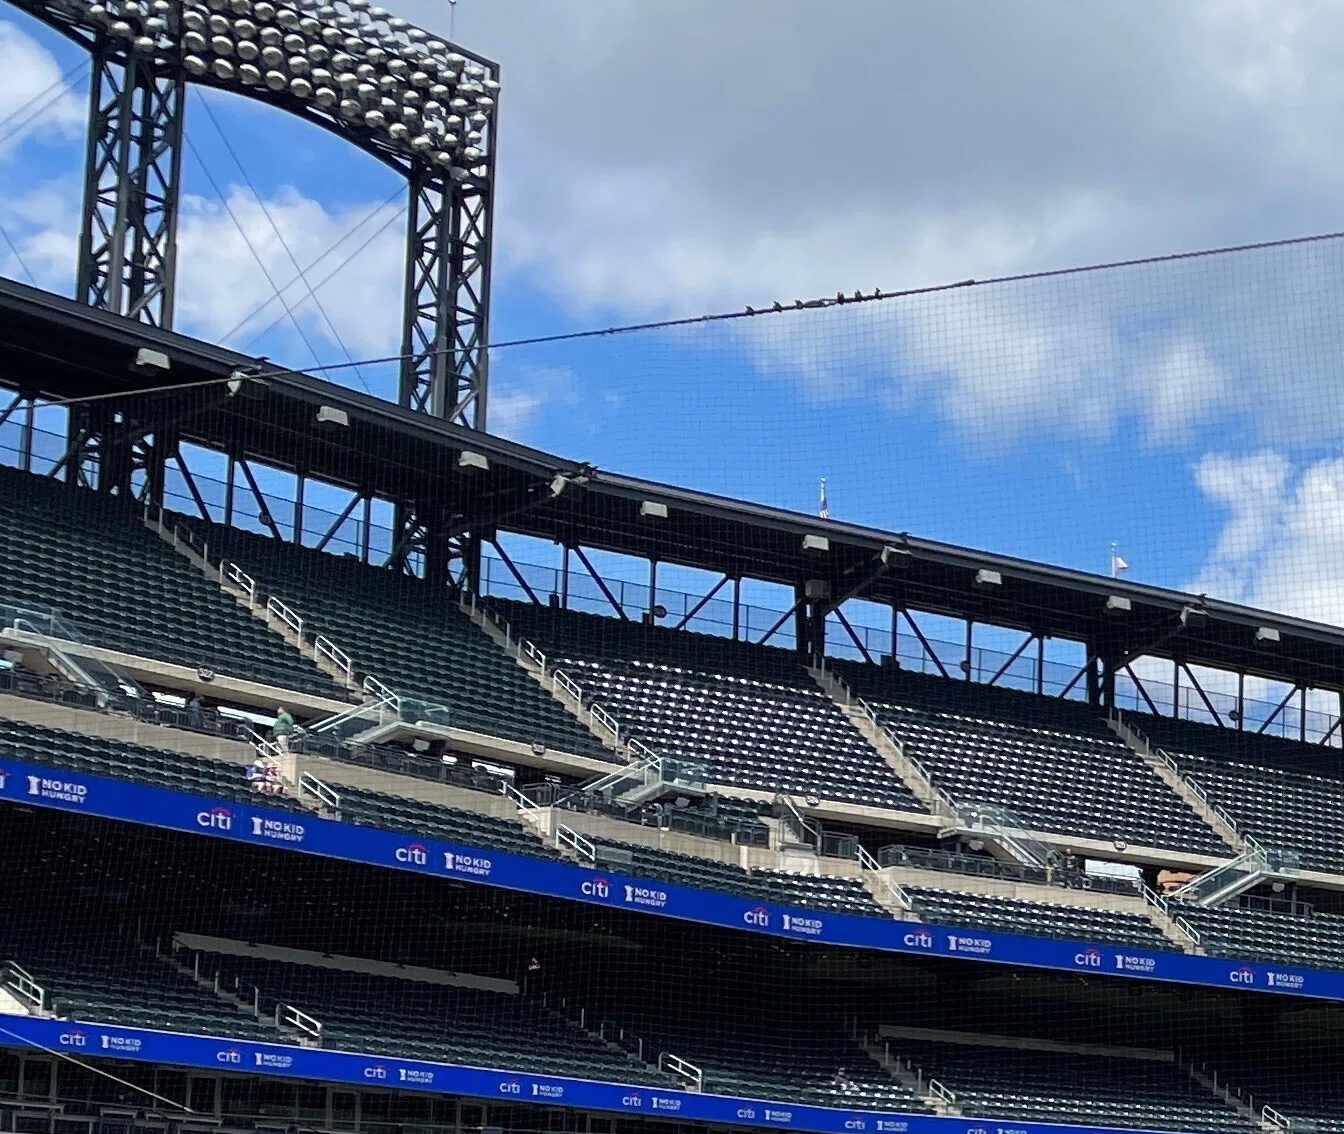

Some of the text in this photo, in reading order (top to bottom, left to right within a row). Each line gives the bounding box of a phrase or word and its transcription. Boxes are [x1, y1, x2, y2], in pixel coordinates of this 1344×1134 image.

[42, 777, 86, 796] NO KID
[42, 789, 84, 804] HUNGRY
[197, 809, 231, 830] citi
[265, 819, 304, 835] NO KID
[264, 830, 302, 843] HUNGRY
[396, 846, 427, 865] citi
[456, 855, 491, 869] NO KID
[456, 865, 490, 876] HUNGRY
[582, 880, 609, 898] citi
[635, 888, 666, 900] NO KID
[635, 898, 665, 907] HUNGRY
[743, 908, 769, 927] citi
[792, 917, 822, 928] NO KID
[903, 931, 932, 948] citi
[959, 936, 991, 948] NO KID
[1074, 951, 1101, 967] citi
[1126, 956, 1155, 966] NO KID
[60, 1031, 86, 1046] citi
[216, 1049, 241, 1063] citi
